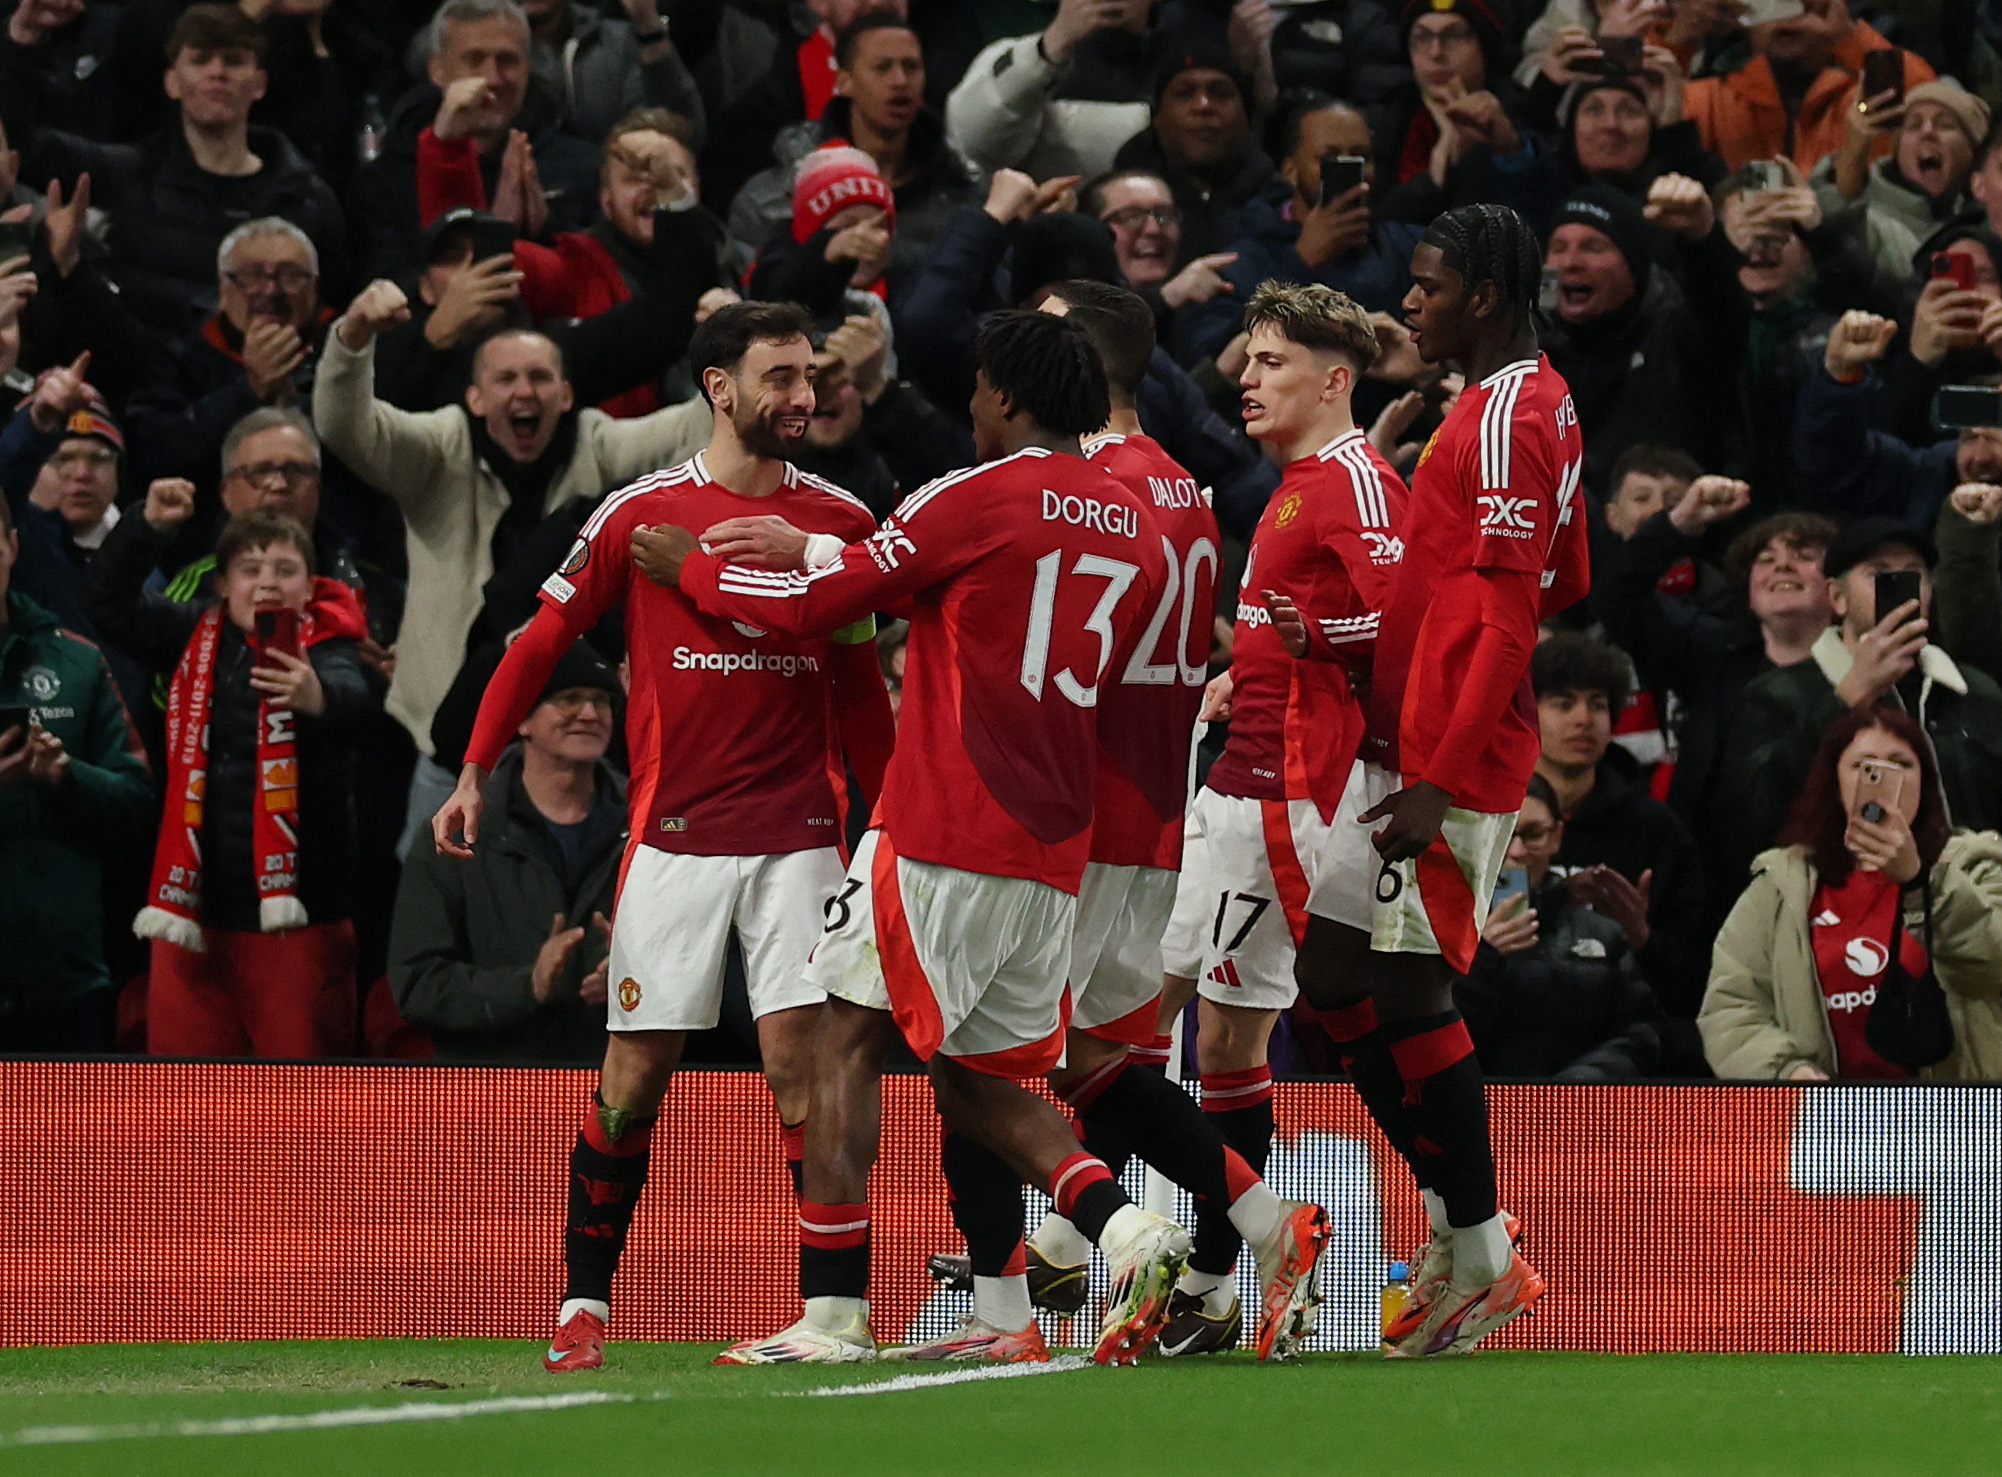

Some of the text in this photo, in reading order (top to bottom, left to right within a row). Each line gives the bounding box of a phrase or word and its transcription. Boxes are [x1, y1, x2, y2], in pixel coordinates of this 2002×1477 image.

[1041, 488, 1138, 539] DORGU
[1146, 475, 1202, 511] DALOT
[1020, 548, 1141, 708] 13
[1120, 534, 1219, 688] 20
[672, 646, 820, 678] Snapdragon
[1212, 890, 1272, 953] 17
